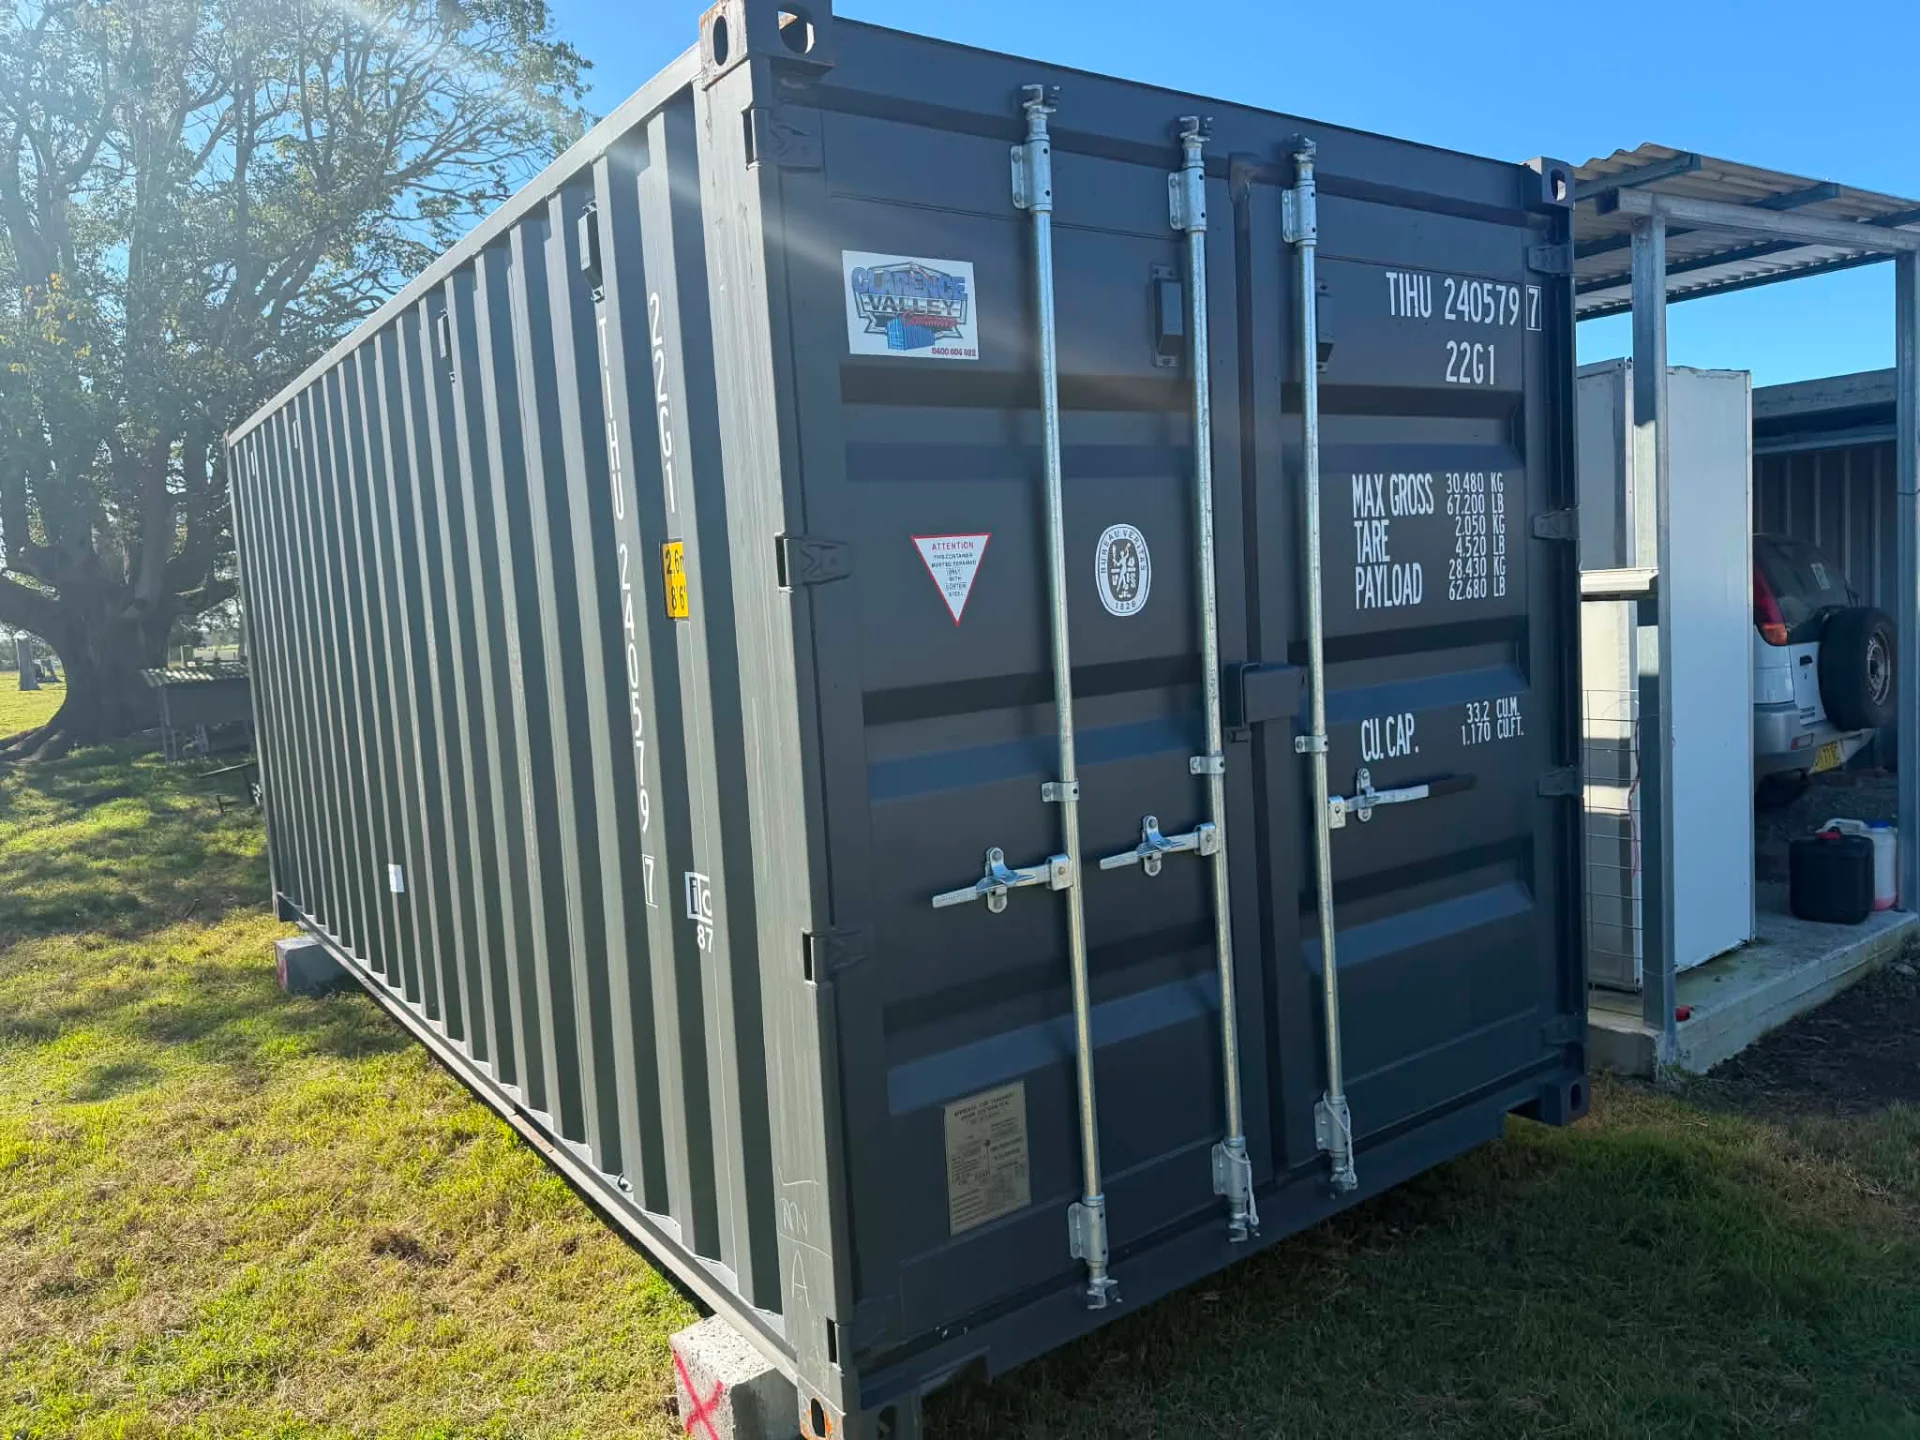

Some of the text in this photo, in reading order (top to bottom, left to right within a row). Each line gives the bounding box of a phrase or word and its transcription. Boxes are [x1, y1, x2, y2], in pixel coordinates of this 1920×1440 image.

[851, 266, 968, 300] CLARENCE
[1386, 272, 1539, 328] TIHU 240579 7
[867, 294, 957, 317] VALLEY
[1445, 340, 1495, 385] 22G1
[649, 292, 676, 514] 22G1
[1352, 472, 1504, 518] MAX GROSS 30.480 KG
[1446, 493, 1504, 515] 67.200 LB
[931, 541, 974, 551] ATTENTION
[1354, 514, 1505, 564] TARE 2.050 KG
[1455, 535, 1505, 557] 4.520 LB
[1355, 556, 1506, 610] PAYLOAD 28.430 KG
[1449, 576, 1506, 600] 62.680 LB
[599, 317, 655, 904] TIHU 240579 7
[1466, 700, 1490, 724] 33.2
[1361, 713, 1419, 762] CU. CAP.
[1461, 721, 1491, 746] 1.170
[697, 923, 713, 953] 87
